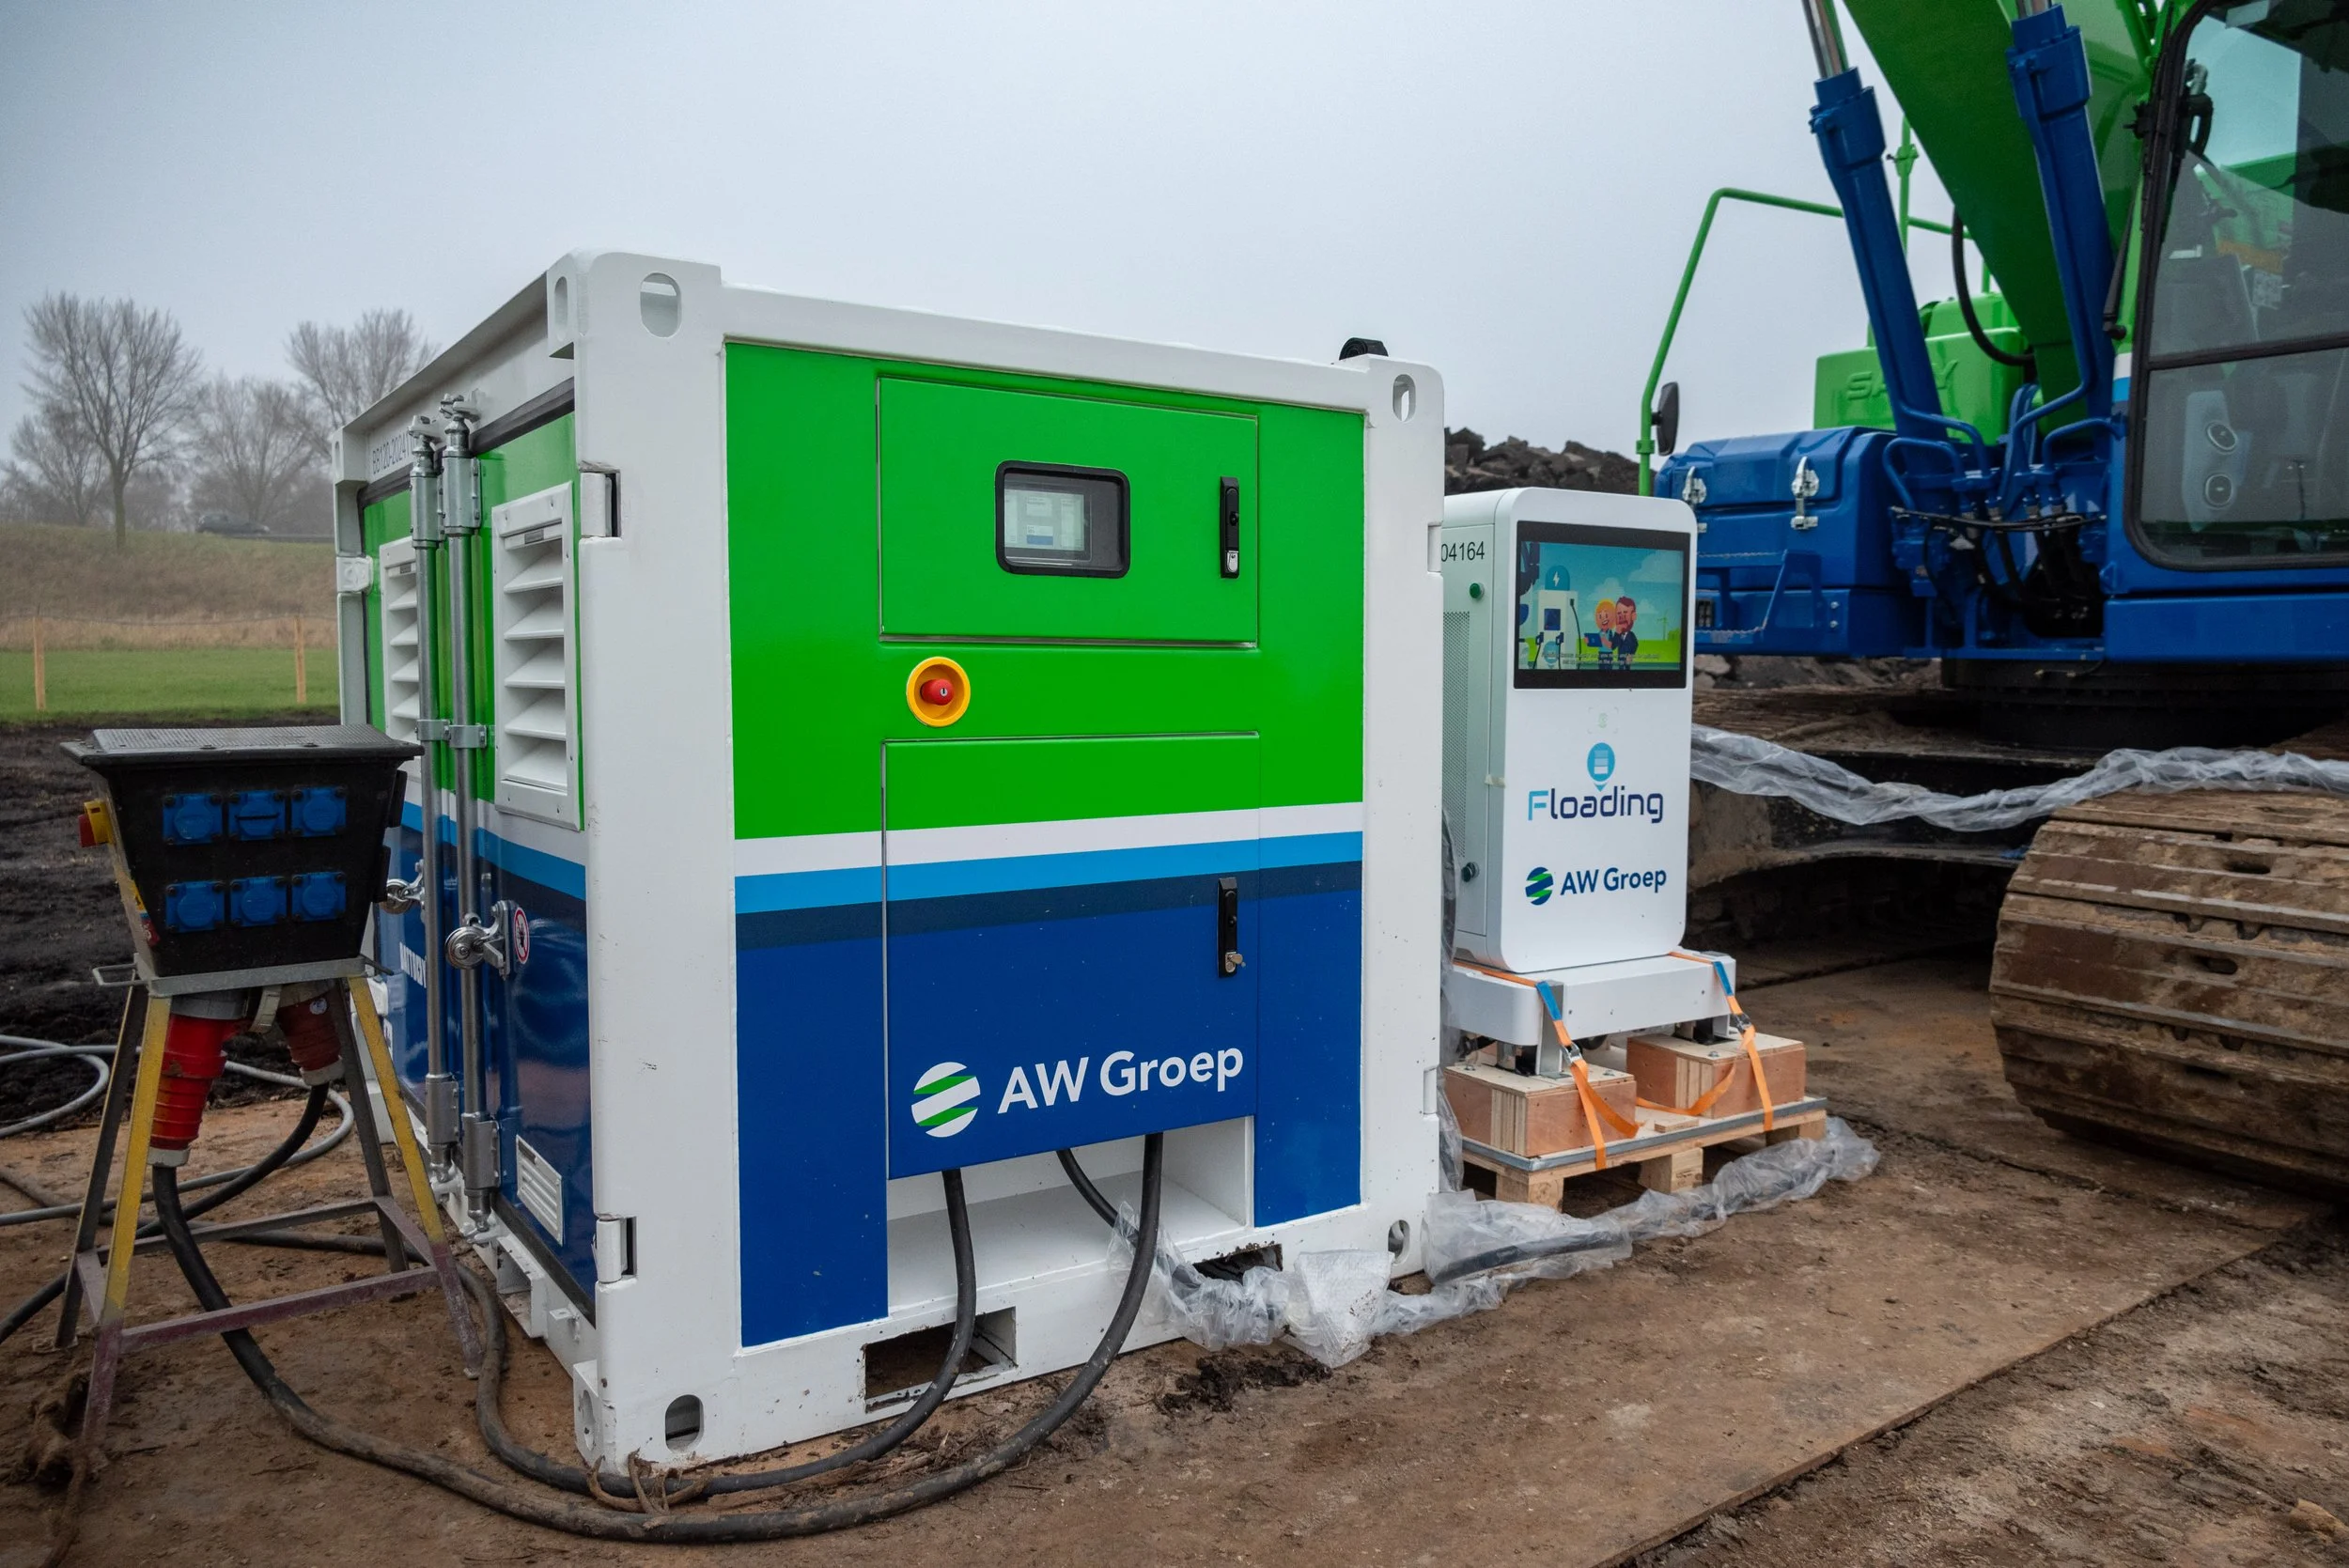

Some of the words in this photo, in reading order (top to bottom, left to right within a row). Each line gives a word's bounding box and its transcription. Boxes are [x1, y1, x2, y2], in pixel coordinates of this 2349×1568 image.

[1440, 541, 1486, 563] 04164
[1528, 785, 1664, 824] Floading
[1560, 869, 1599, 896] AW
[1603, 867, 1667, 893] Groep
[997, 1056, 1089, 1114] AW
[1099, 1048, 1243, 1096] Groep
